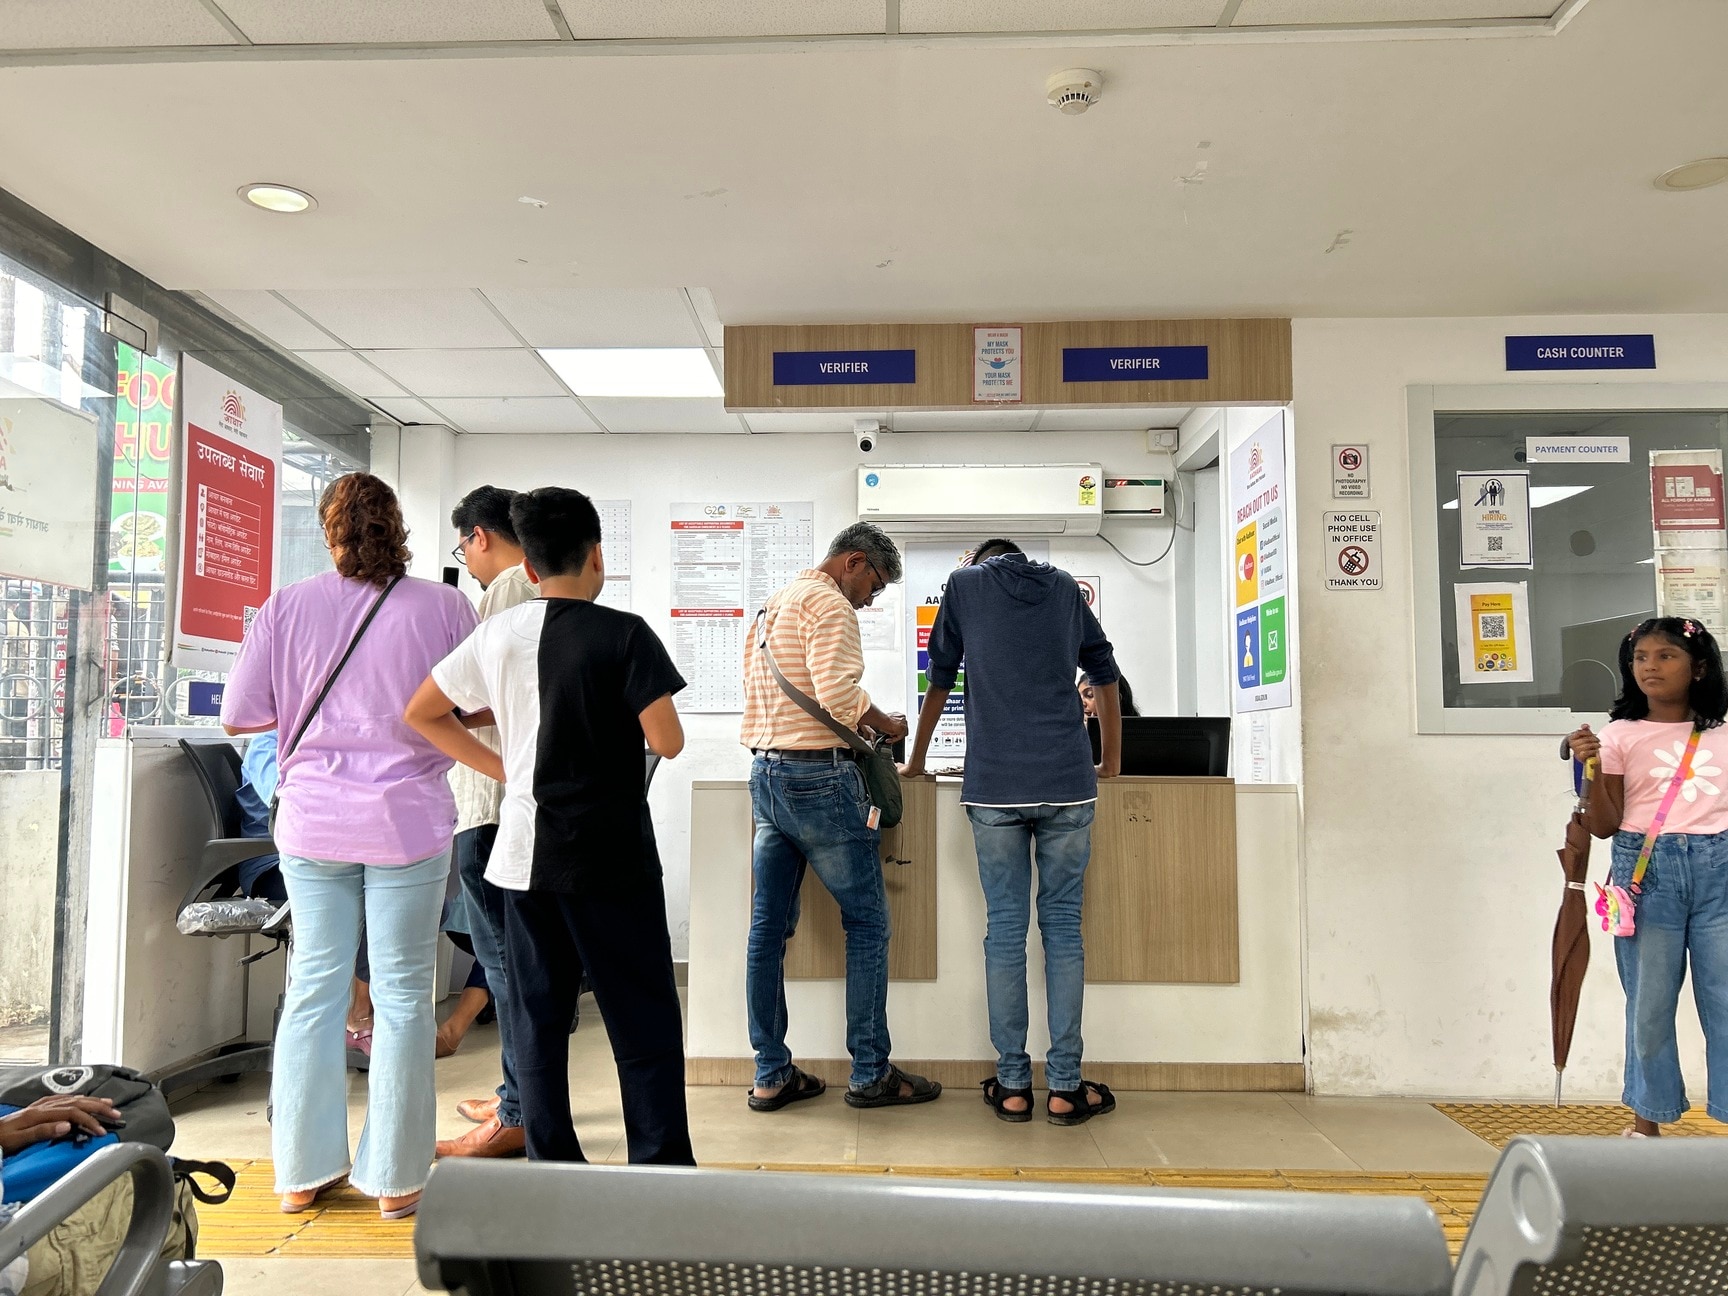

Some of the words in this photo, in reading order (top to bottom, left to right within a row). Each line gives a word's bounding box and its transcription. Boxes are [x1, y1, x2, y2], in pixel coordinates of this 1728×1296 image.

[1537, 348, 1567, 358] CASH
[1570, 347, 1624, 358] COUNTER
[820, 362, 869, 373] VERIFIER
[1110, 358, 1160, 370] VERIFIER
[196, 441, 236, 472] उपलब्ध
[239, 454, 265, 488] सेवाएं
[1237, 502, 1252, 524] REACH
[1253, 494, 1263, 514] OUT
[1263, 489, 1270, 507] TO
[1270, 484, 1278, 501] US
